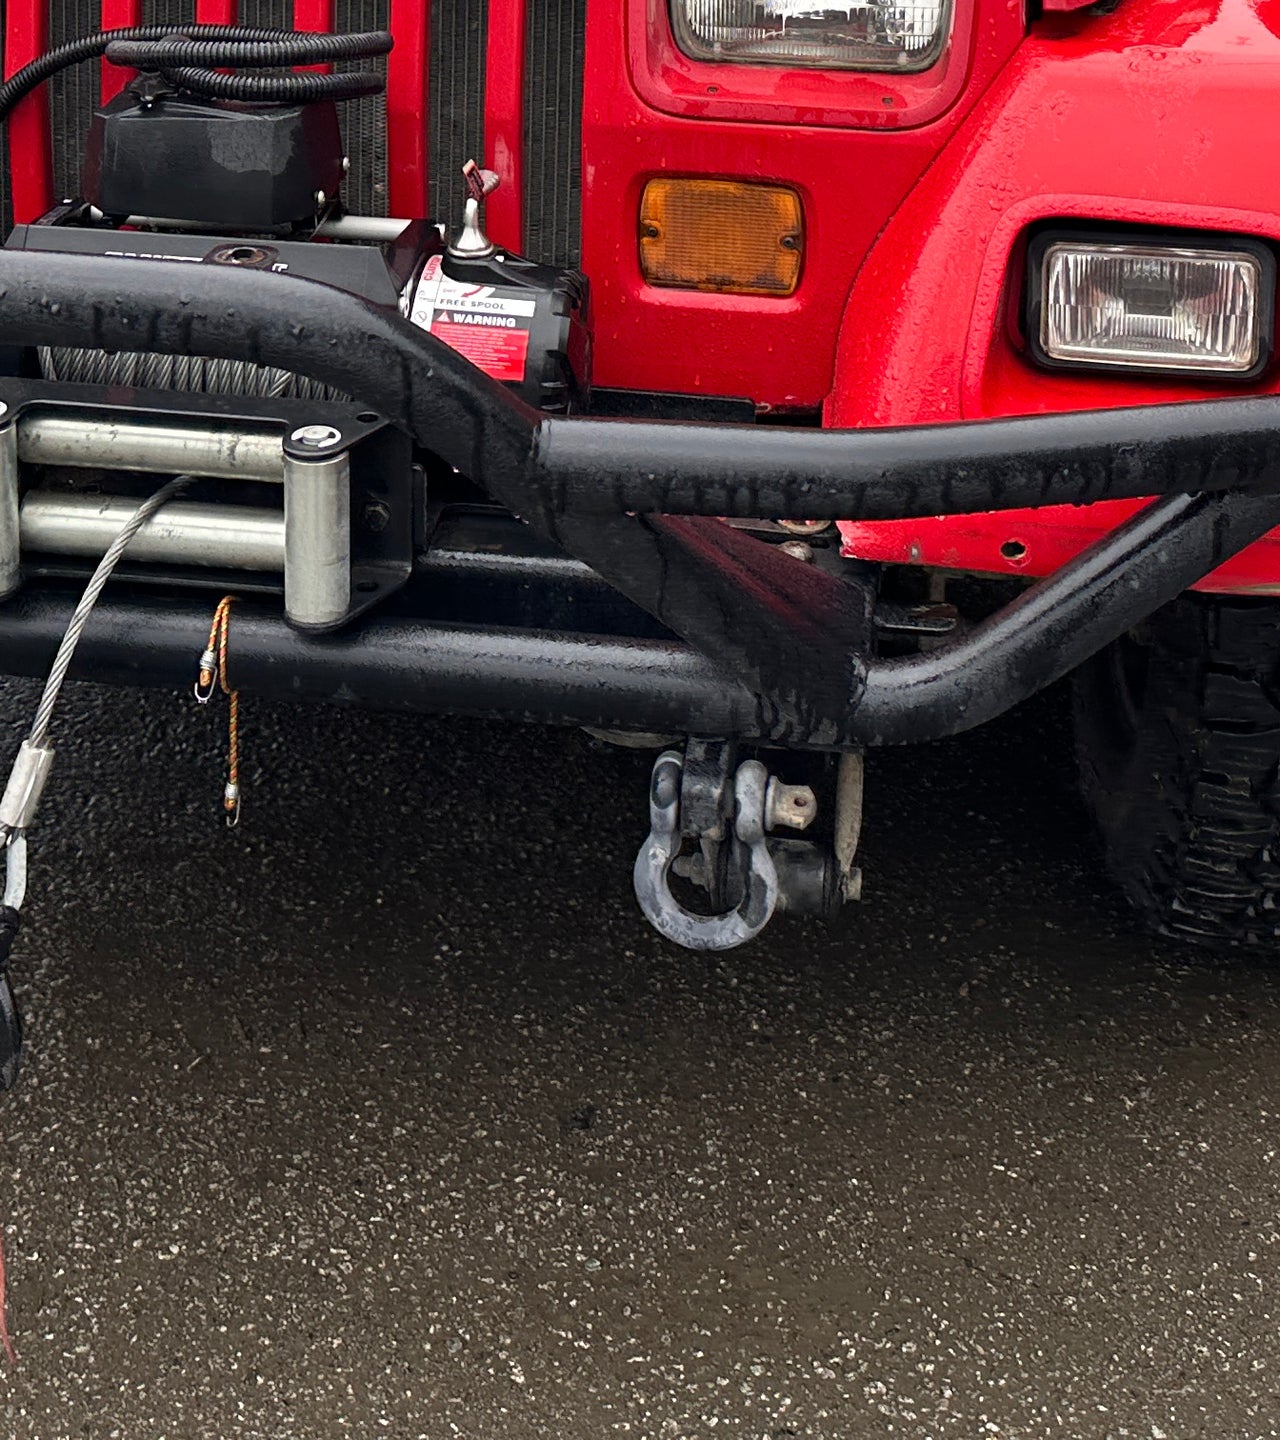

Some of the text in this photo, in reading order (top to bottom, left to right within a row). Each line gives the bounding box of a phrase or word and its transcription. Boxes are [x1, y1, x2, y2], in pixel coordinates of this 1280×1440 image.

[439, 298, 466, 308] FREE
[470, 300, 506, 310] SPOOL
[453, 313, 516, 328] WARNING
